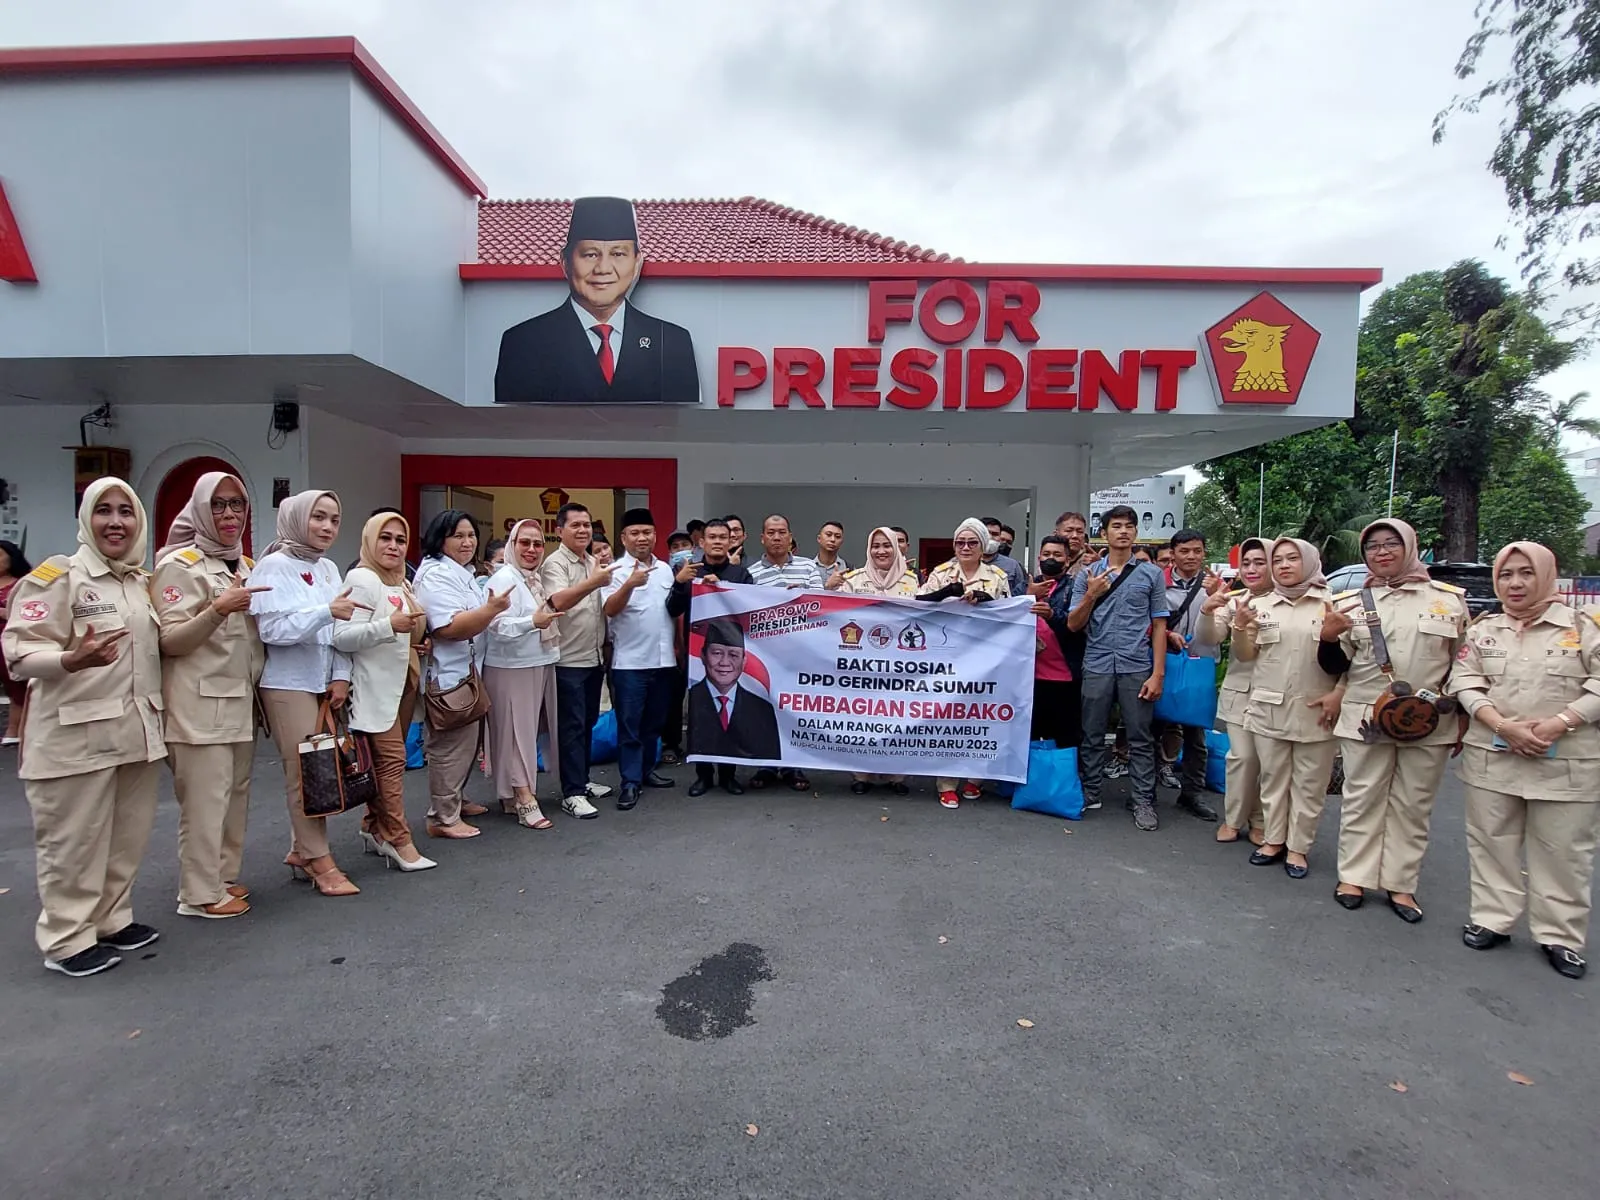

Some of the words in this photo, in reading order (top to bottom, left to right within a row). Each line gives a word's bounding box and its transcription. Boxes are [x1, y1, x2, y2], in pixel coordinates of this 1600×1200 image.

[868, 279, 1041, 344] FOR
[717, 347, 1197, 411] PRESIDENT
[750, 602, 820, 624] PRABOWO
[750, 614, 807, 633] PRESIDEN
[749, 627, 791, 640] GERINDRA
[792, 620, 829, 633] MENANG
[836, 657, 890, 673] BAKTI
[893, 660, 956, 675] SOSIAL
[798, 672, 835, 687] DPD
[838, 675, 930, 693] GERINDRA
[932, 680, 997, 695] SUMUT
[778, 693, 905, 718] PEMBAGIAN
[909, 701, 1014, 722] SEMBAKO
[798, 718, 844, 731] DALAM
[846, 721, 903, 735] RANGKA
[905, 725, 990, 737] MENYAMBUT
[791, 729, 833, 744] NATAL
[835, 734, 866, 747] 2022
[867, 737, 878, 747] &
[881, 738, 926, 749] TAHUN
[928, 739, 964, 749] BARU
[966, 740, 998, 751] 2023
[971, 752, 998, 760] SUMUT
